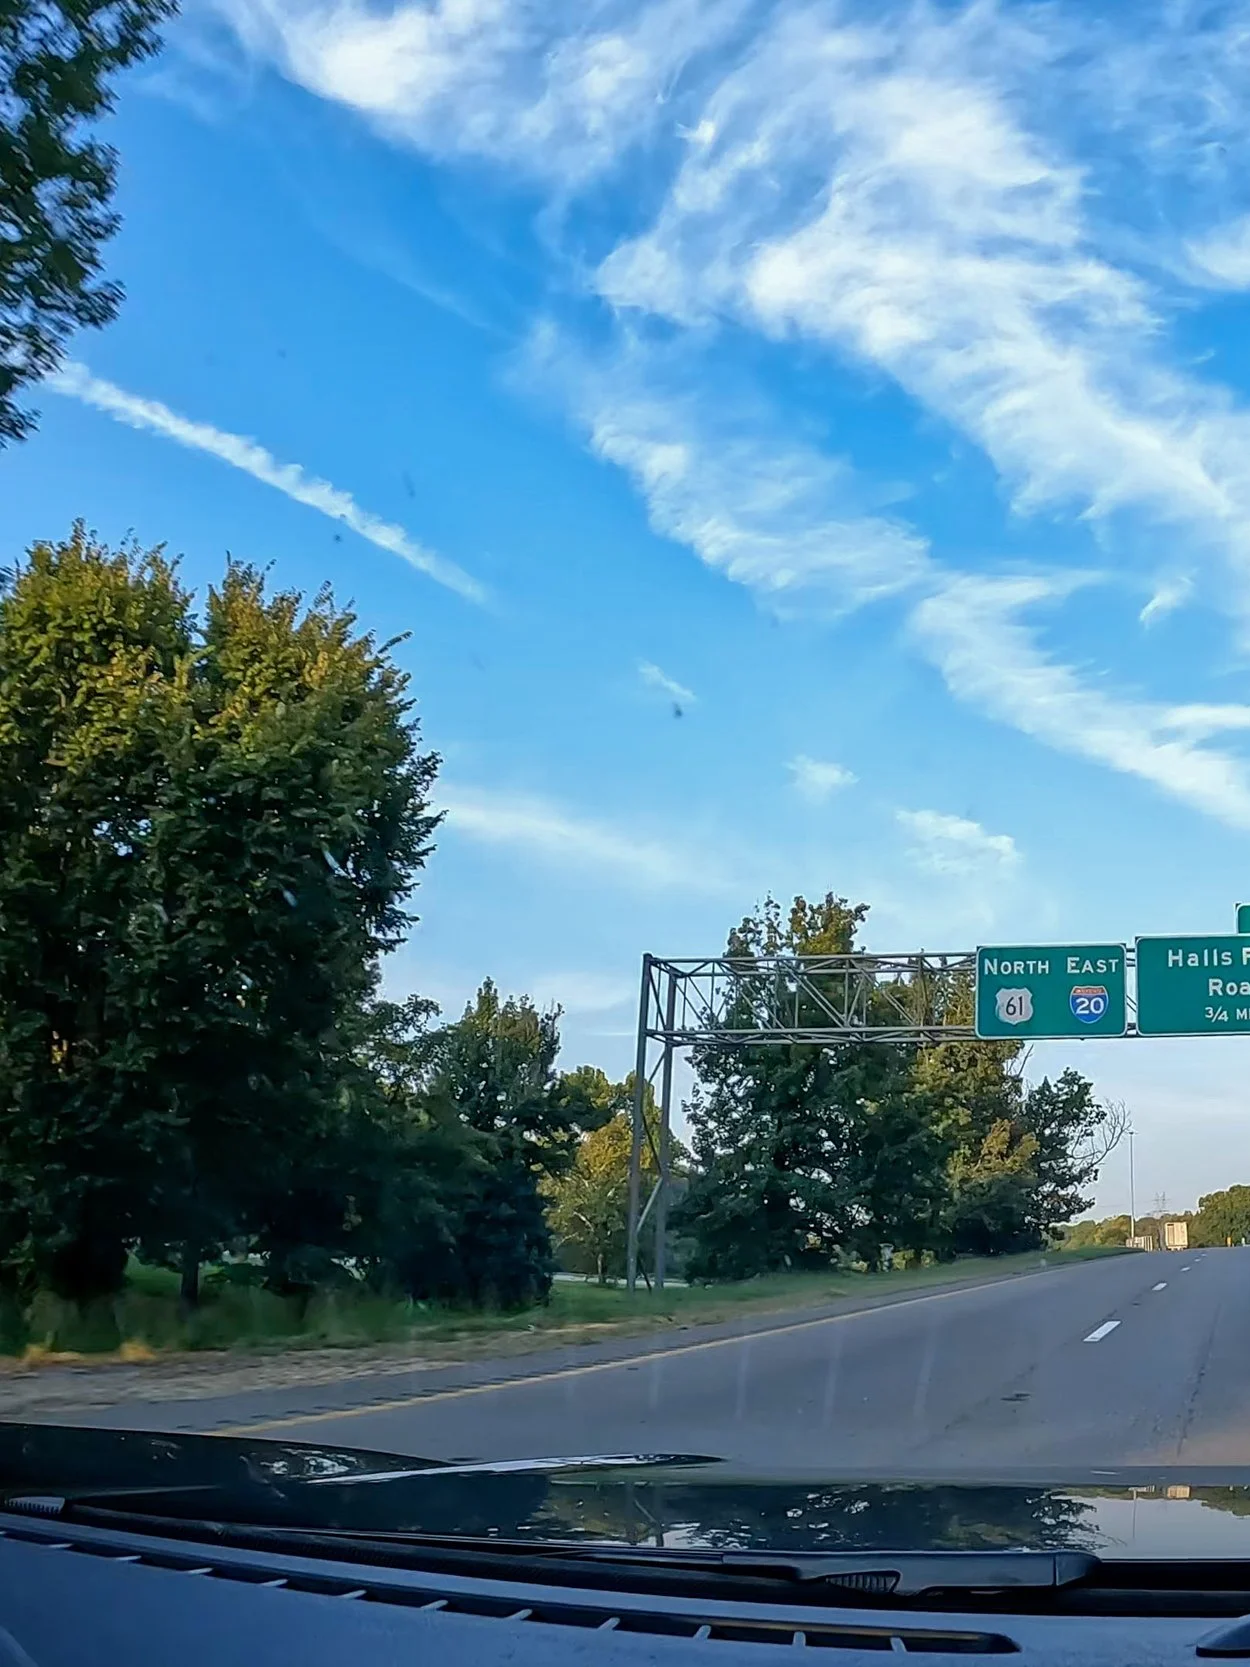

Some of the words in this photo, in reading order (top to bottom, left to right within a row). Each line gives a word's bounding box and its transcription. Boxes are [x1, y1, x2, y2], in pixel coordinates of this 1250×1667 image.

[984, 958, 1049, 976] NORTH
[1067, 956, 1119, 974] EAST
[1168, 949, 1233, 968] Halls
[1005, 996, 1023, 1016] 61
[1075, 997, 1104, 1014] 20
